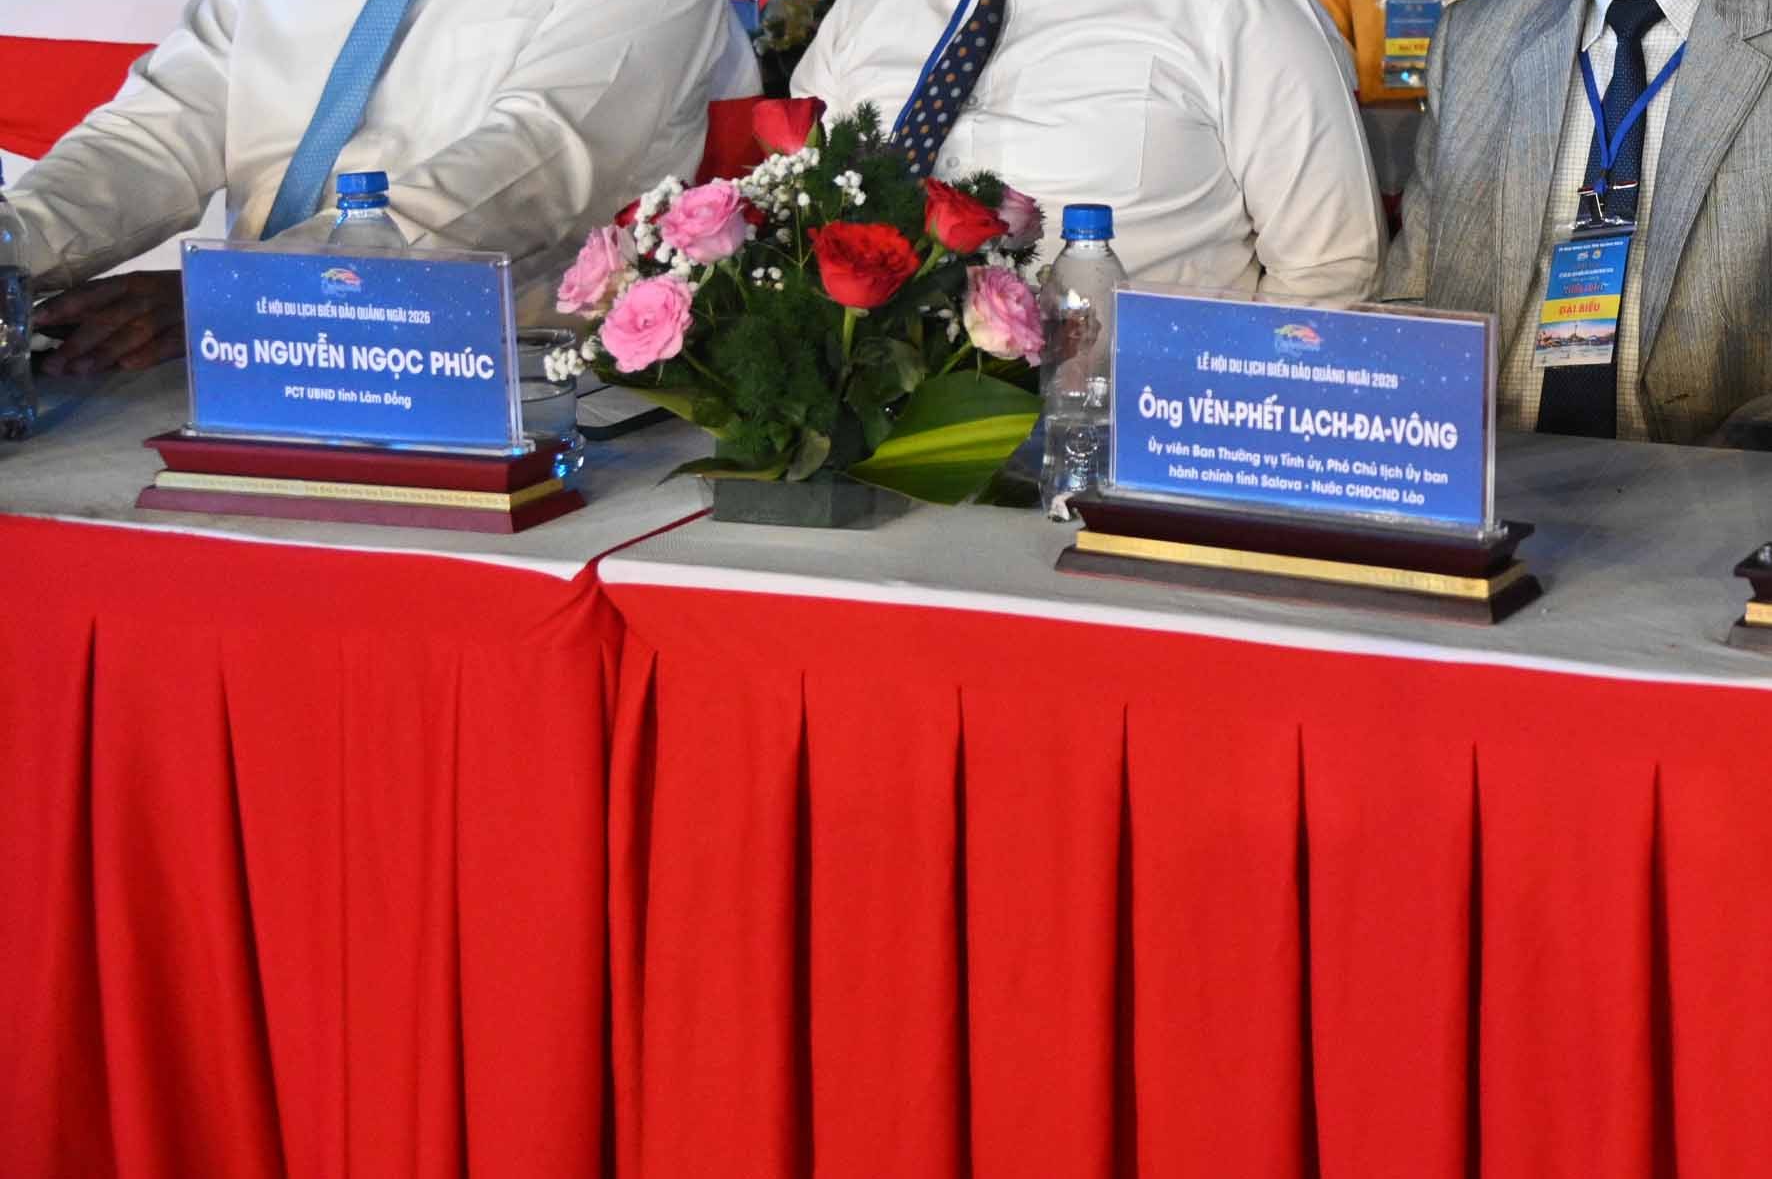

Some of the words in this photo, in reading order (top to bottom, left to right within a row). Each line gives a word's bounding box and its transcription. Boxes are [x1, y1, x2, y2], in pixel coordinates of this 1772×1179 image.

[256, 296, 267, 315] LỄ
[269, 299, 283, 317] HỘI
[284, 301, 296, 316] DU
[298, 302, 316, 319] LỊCH
[408, 310, 431, 324] 2026
[201, 330, 248, 369] Ông
[254, 332, 345, 369] NGUYỄN
[352, 346, 424, 380] NGỌC
[430, 346, 494, 379] PHÚC
[1197, 351, 1209, 370] LỄ
[1211, 355, 1227, 374] HỘI
[1229, 358, 1242, 374] DU
[1244, 360, 1266, 377] LỊCH
[1372, 372, 1399, 389] 2026
[285, 386, 304, 398] PCT
[308, 387, 335, 401] UBND
[338, 387, 357, 402] tỉnh
[360, 390, 381, 404] Lâm
[384, 390, 411, 409] Đồng
[1139, 385, 1183, 428] Ông
[1188, 389, 1284, 432] VẺN-PHẾT
[1290, 406, 1458, 450] LẠCH-ĐA-VÔNG
[1148, 436, 1163, 455] Ủy
[1166, 442, 1189, 456] viên
[1192, 444, 1215, 459] Ban
[1218, 446, 1261, 467] Thường
[1263, 455, 1278, 470] vụ
[1280, 452, 1304, 469] Tỉnh
[1327, 458, 1350, 474] Phó
[1352, 461, 1377, 477] Chủ
[1380, 464, 1402, 481] lịch
[1405, 462, 1421, 483] Ủy
[1423, 469, 1448, 485] ban
[1169, 464, 1199, 480] hành
[1201, 468, 1234, 484] chính
[1236, 469, 1258, 486] tỉnh
[1311, 480, 1343, 496] Nước
[1346, 483, 1399, 502] CHDCND
[1402, 489, 1425, 505] Lào
